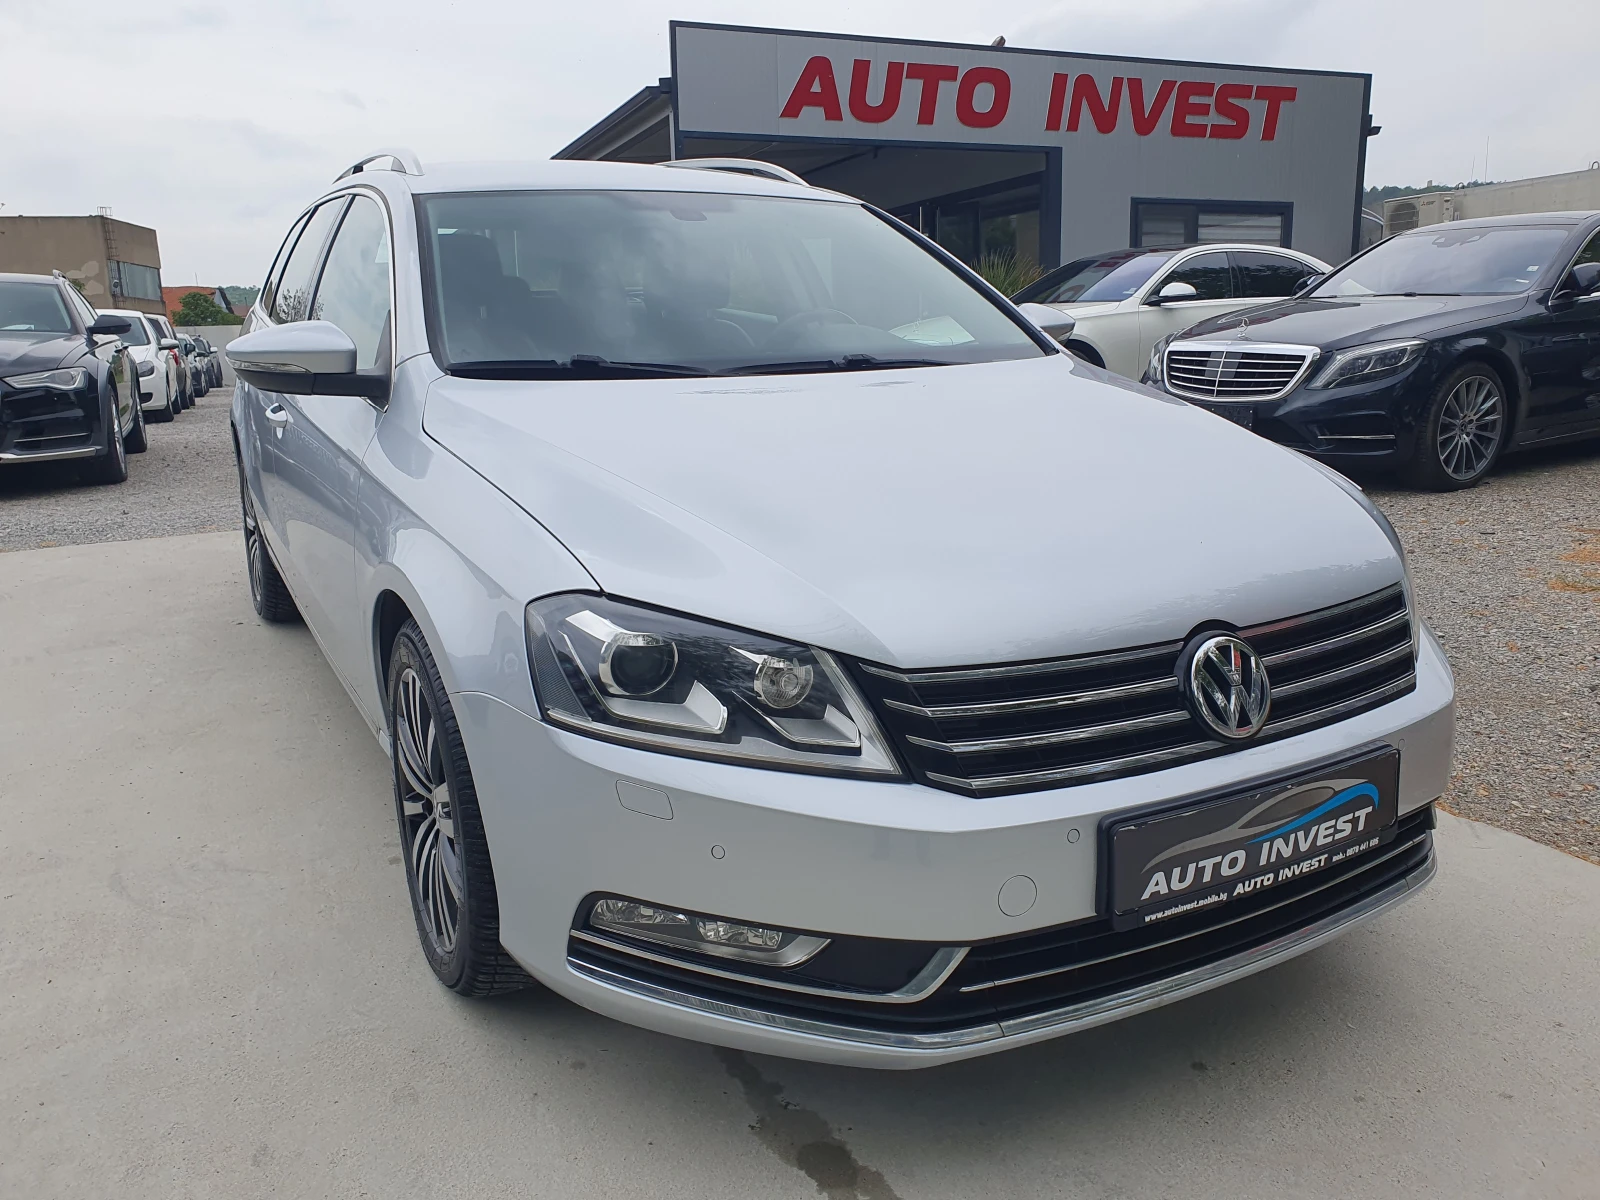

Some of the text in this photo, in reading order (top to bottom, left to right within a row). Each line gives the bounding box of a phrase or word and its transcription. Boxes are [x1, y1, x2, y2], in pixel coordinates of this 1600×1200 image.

[779, 55, 1298, 141] AUTO INVEST
[1141, 806, 1373, 900] AUTO INVEST
[1232, 872, 1275, 896] AUTO
[1277, 854, 1329, 882] INVEST
